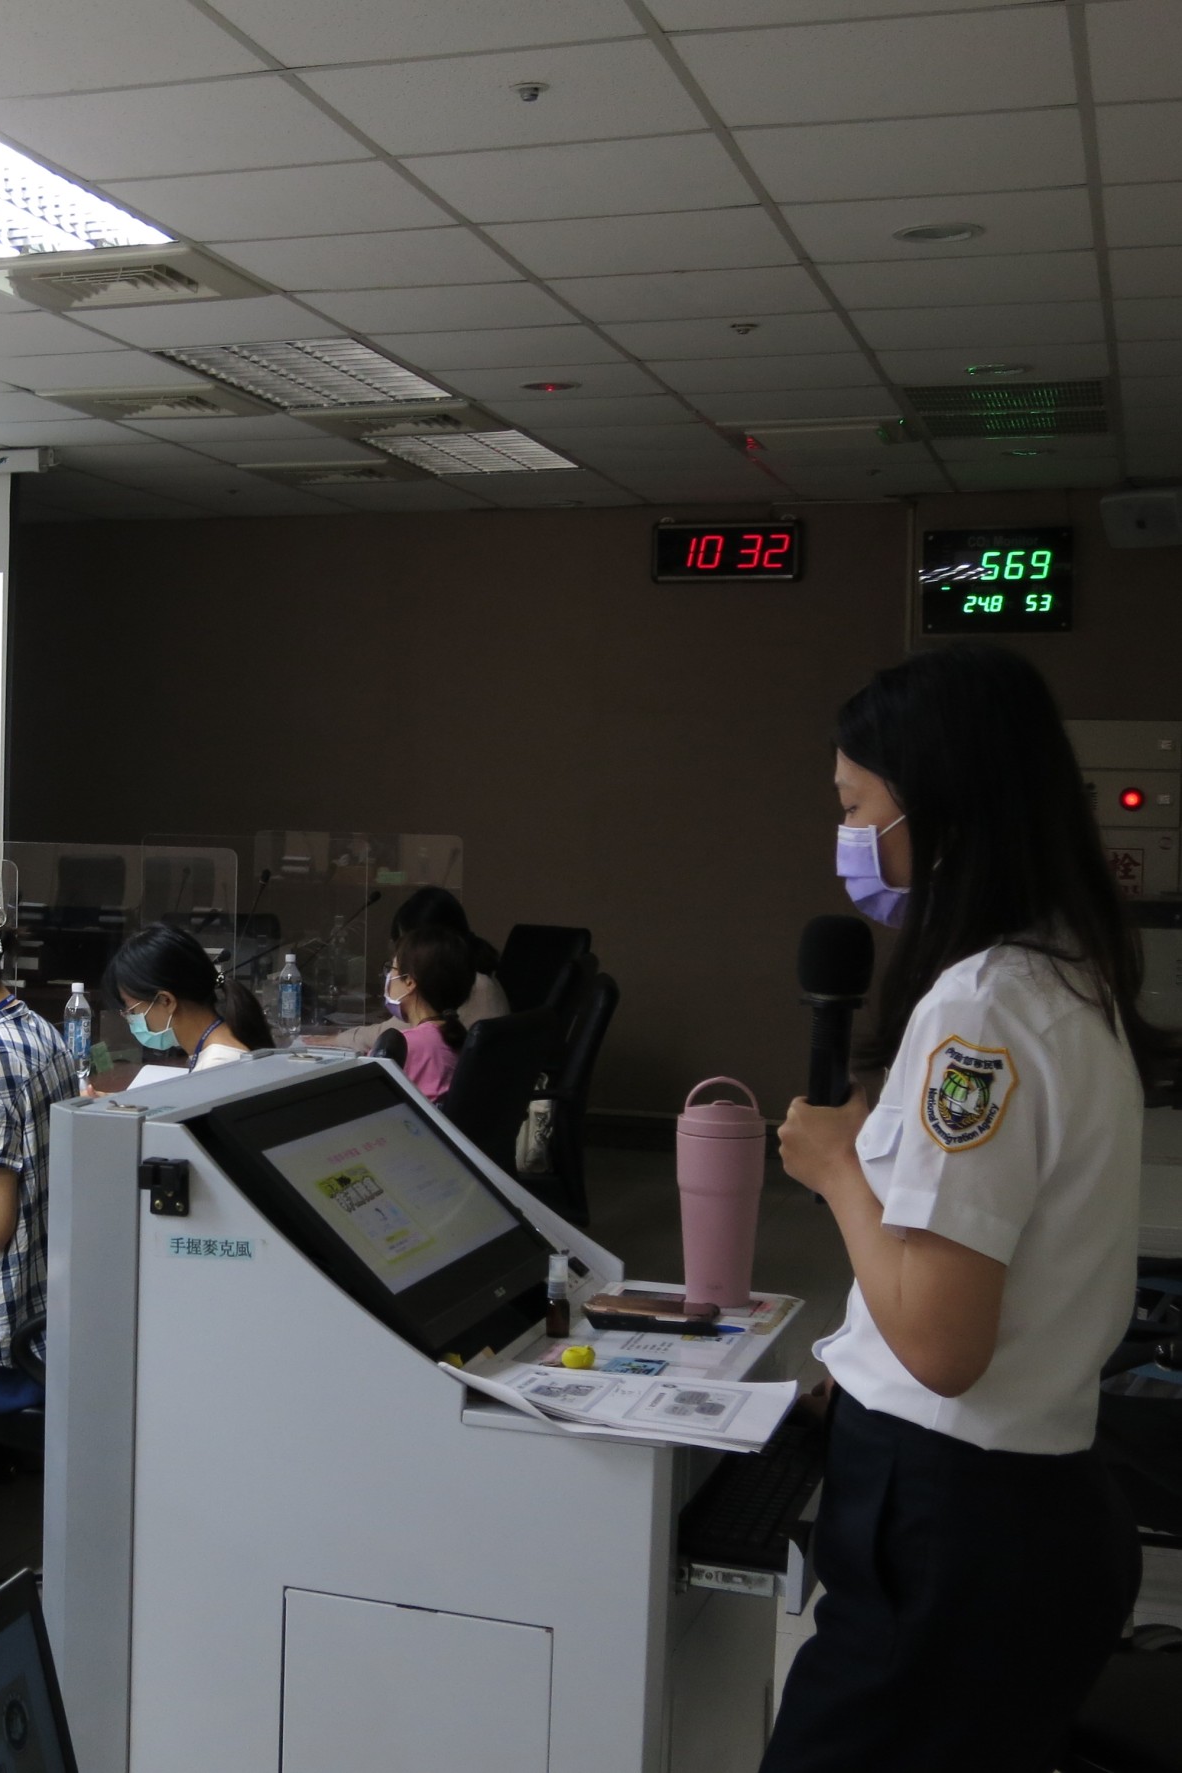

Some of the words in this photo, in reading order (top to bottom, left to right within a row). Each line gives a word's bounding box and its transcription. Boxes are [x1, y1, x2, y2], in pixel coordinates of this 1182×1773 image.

[686, 535, 723, 569] 10
[737, 534, 790, 569] 32
[980, 550, 1052, 581] 569
[1025, 594, 1053, 613] 53
[927, 1087, 938, 1123] National
[978, 1103, 1000, 1135] Agency
[932, 1121, 979, 1145] Immigration
[170, 1237, 252, 1258] 手握麥克風
